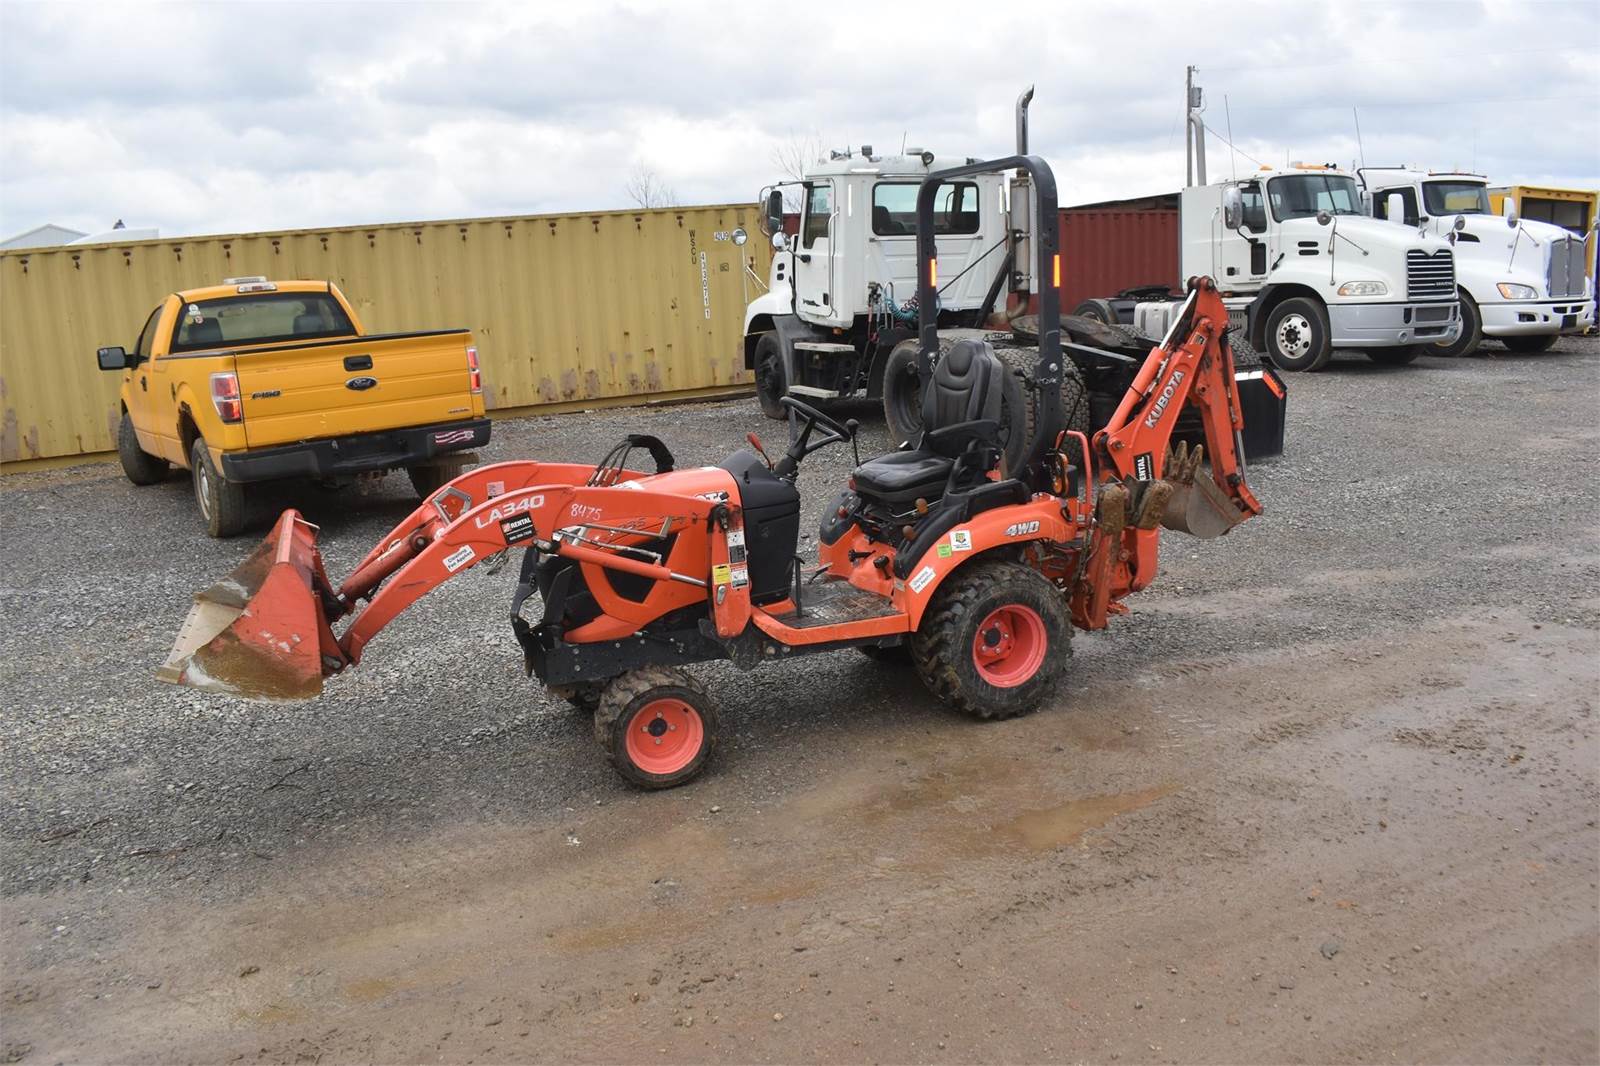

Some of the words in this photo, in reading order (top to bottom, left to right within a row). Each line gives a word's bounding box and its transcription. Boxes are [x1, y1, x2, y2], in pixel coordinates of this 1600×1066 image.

[689, 229, 697, 264] WSCU
[1145, 371, 1184, 428] KUBOTA
[1137, 456, 1145, 481] ENTAL
[475, 495, 545, 529] LA340
[510, 517, 532, 529] RENTAL
[570, 503, 603, 521] 8475
[1006, 521, 1040, 536] 4WD
